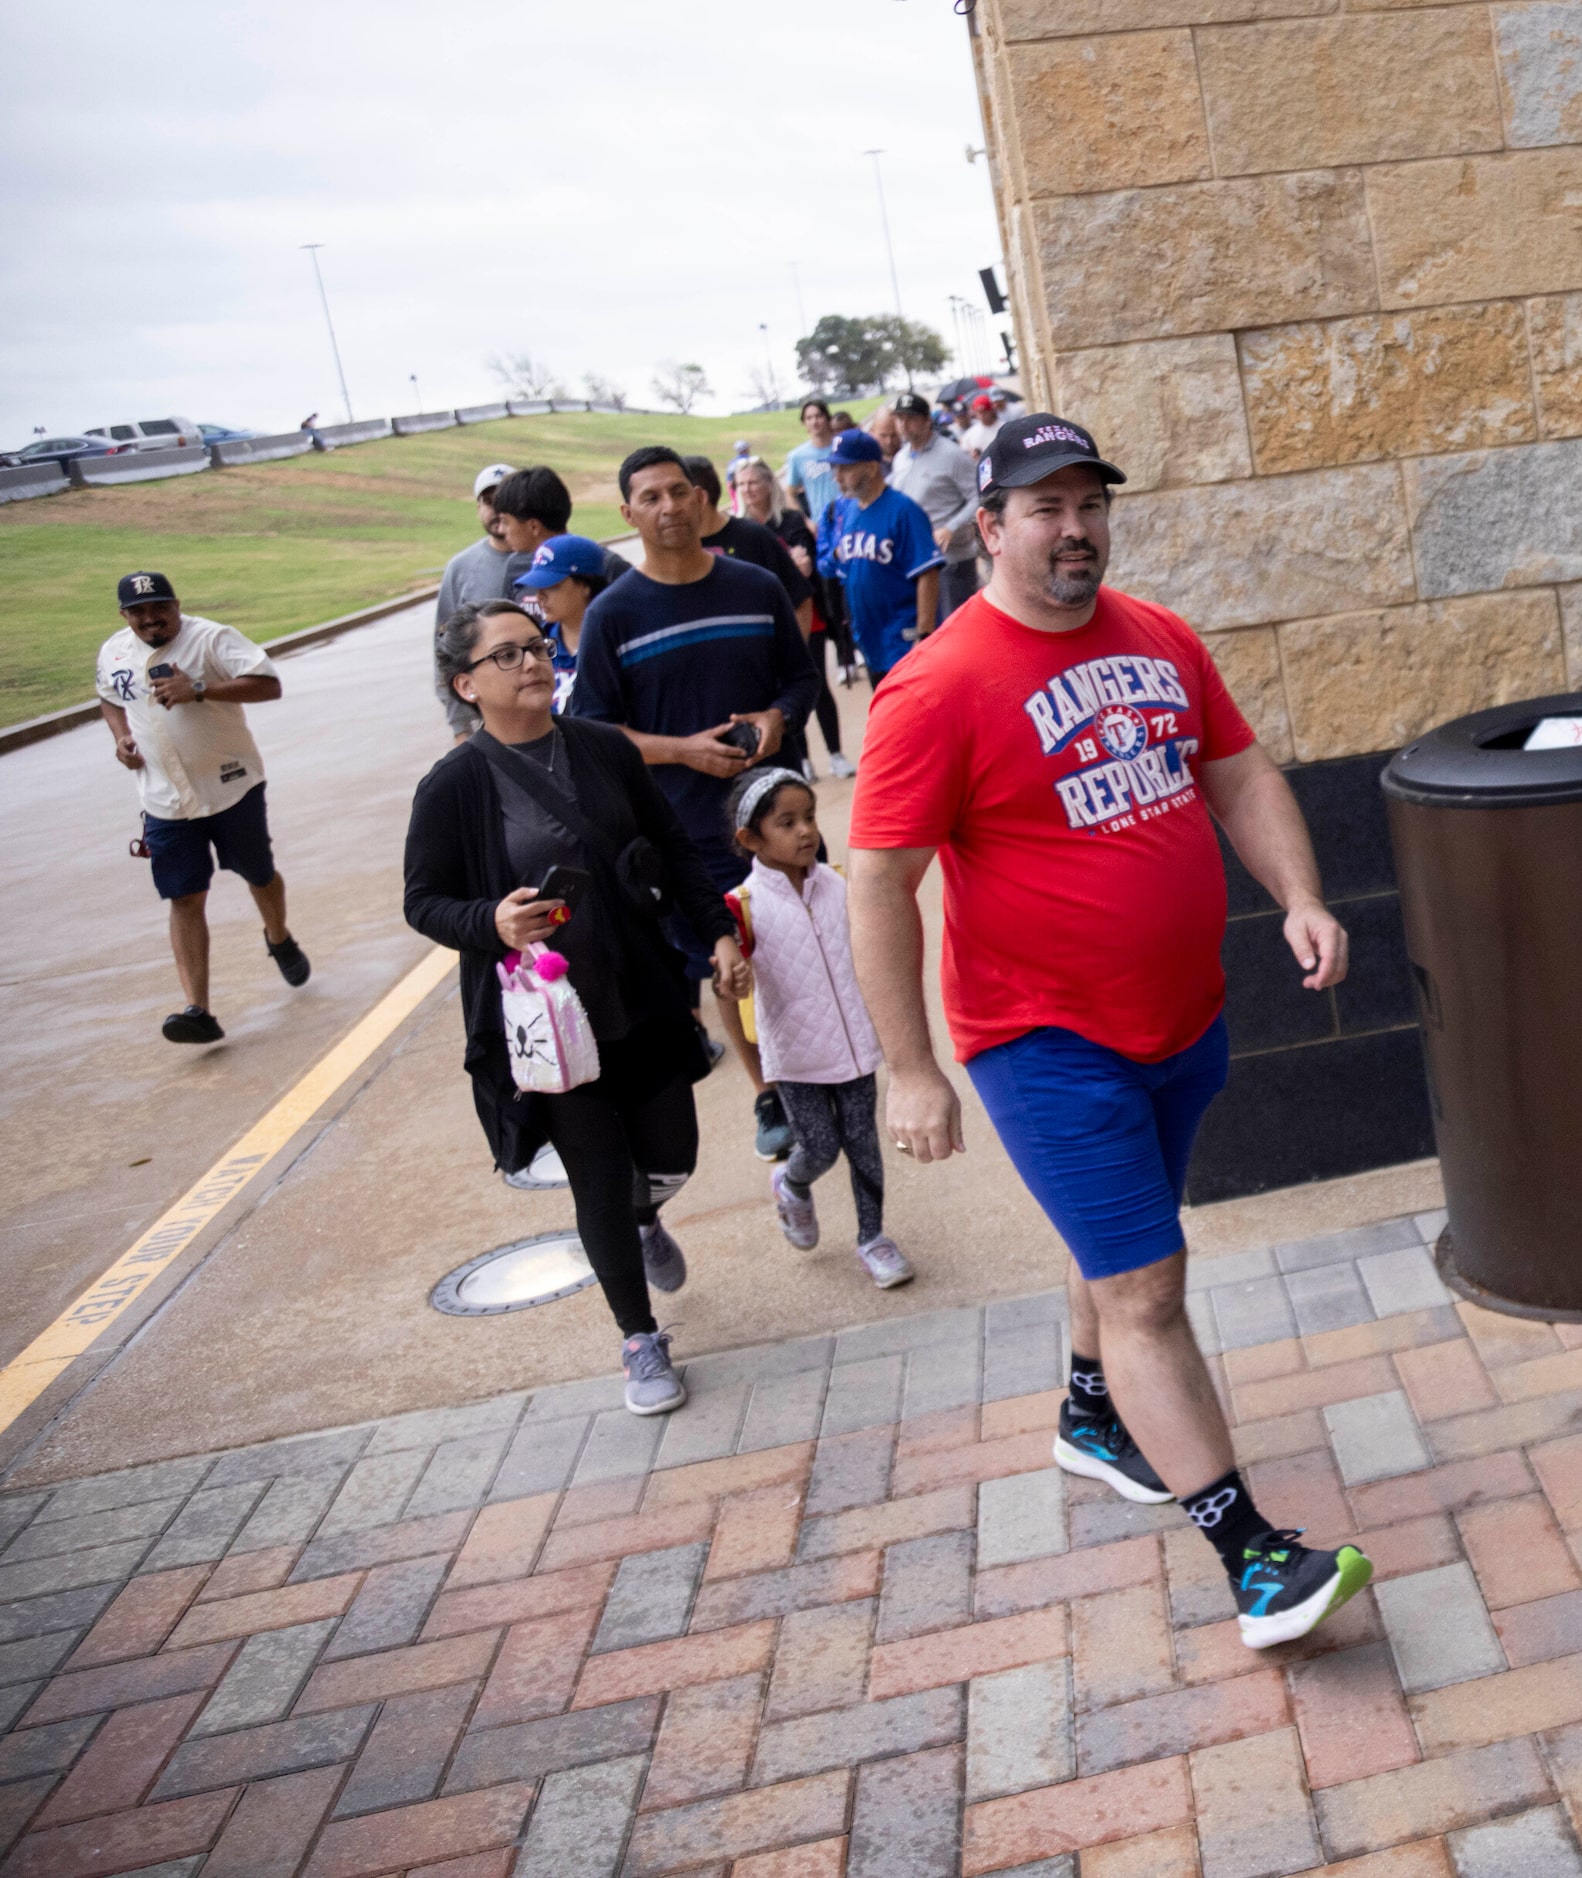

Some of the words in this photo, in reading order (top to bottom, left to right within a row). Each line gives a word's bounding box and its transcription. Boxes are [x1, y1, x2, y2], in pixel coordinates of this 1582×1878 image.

[1024, 655, 1190, 756] RANGERS
[1074, 738, 1099, 763] 19
[1150, 713, 1178, 738] 72
[1100, 815, 1137, 835] LONE
[1139, 802, 1170, 821] STAR
[178, 1152, 270, 1212] WATCH
[122, 1214, 209, 1268] YOUR
[65, 1272, 150, 1325] STEP
